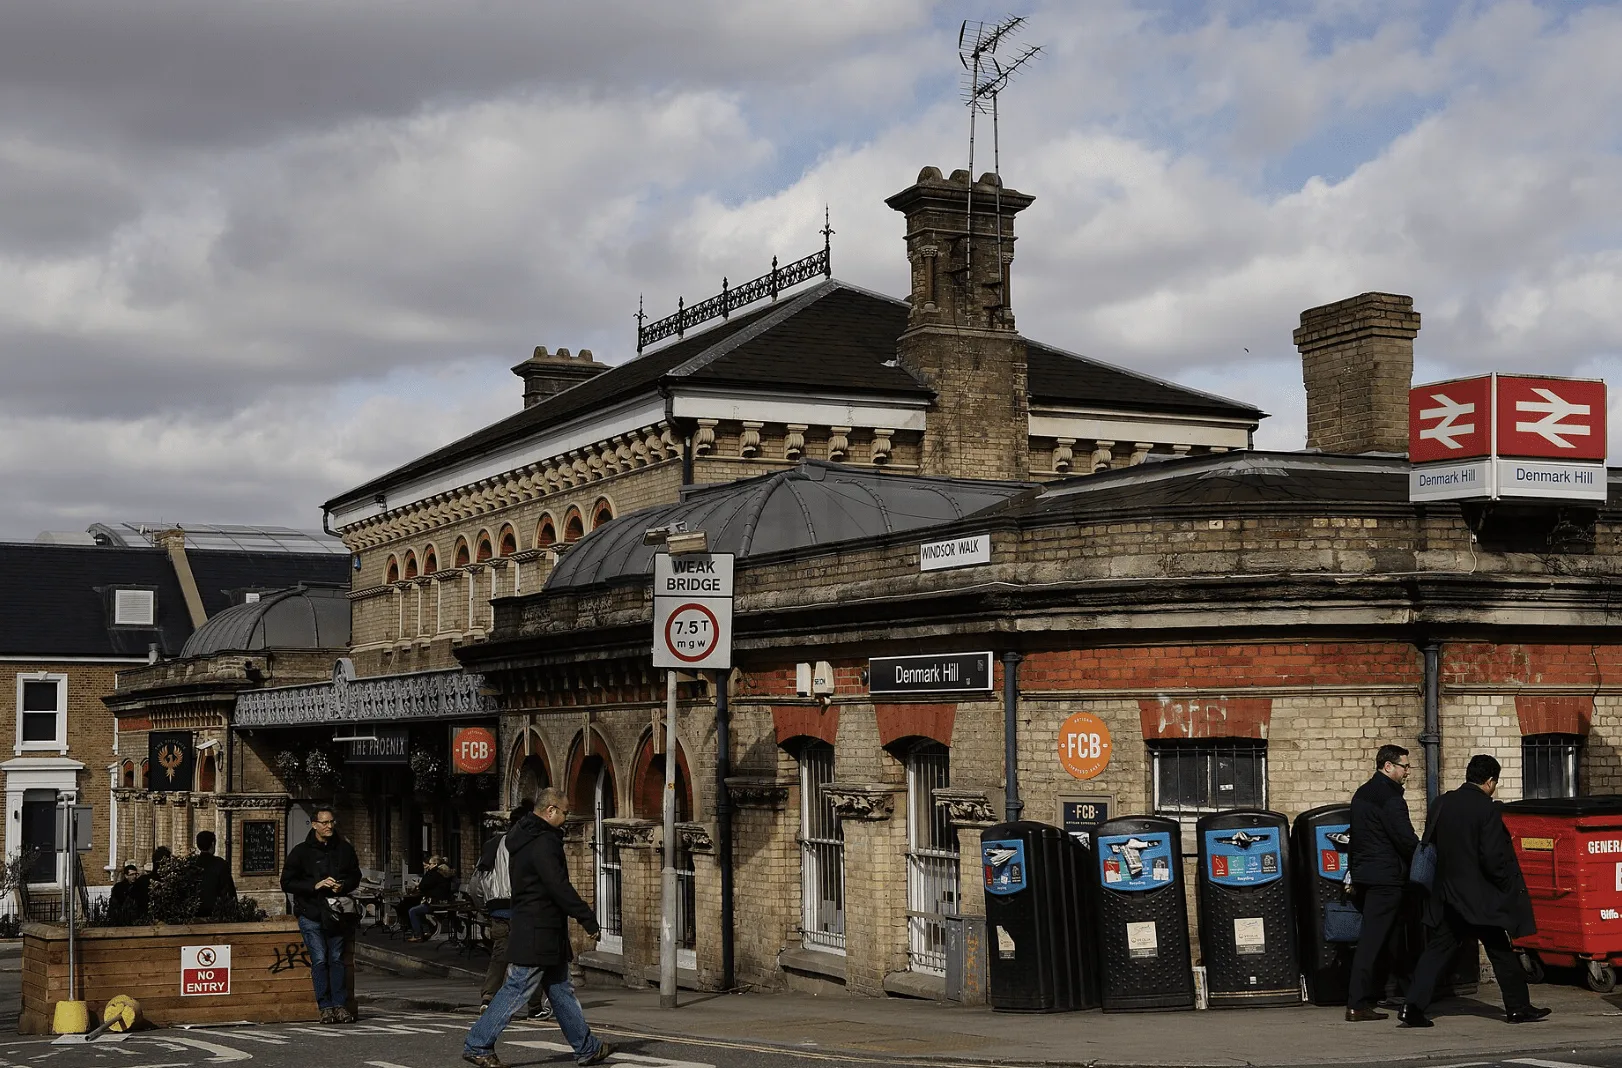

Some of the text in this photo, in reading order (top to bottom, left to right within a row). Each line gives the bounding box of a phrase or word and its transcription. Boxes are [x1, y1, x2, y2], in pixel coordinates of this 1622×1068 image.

[1419, 468, 1476, 487] Denmark Hill
[1516, 468, 1593, 484] Denmark Hill
[921, 539, 979, 560] WINDSOR WALK
[673, 560, 715, 574] WEAK
[666, 577, 721, 591] BRIDGE
[895, 662, 959, 684] Denmark Hill
[352, 736, 405, 756] THE PHOENIX
[461, 741, 489, 760] FCB
[1067, 733, 1101, 759] FCB
[1076, 804, 1096, 820] FCB
[1600, 908, 1619, 920] Biffa
[197, 970, 215, 981] NO
[186, 981, 226, 993] ENTRY
